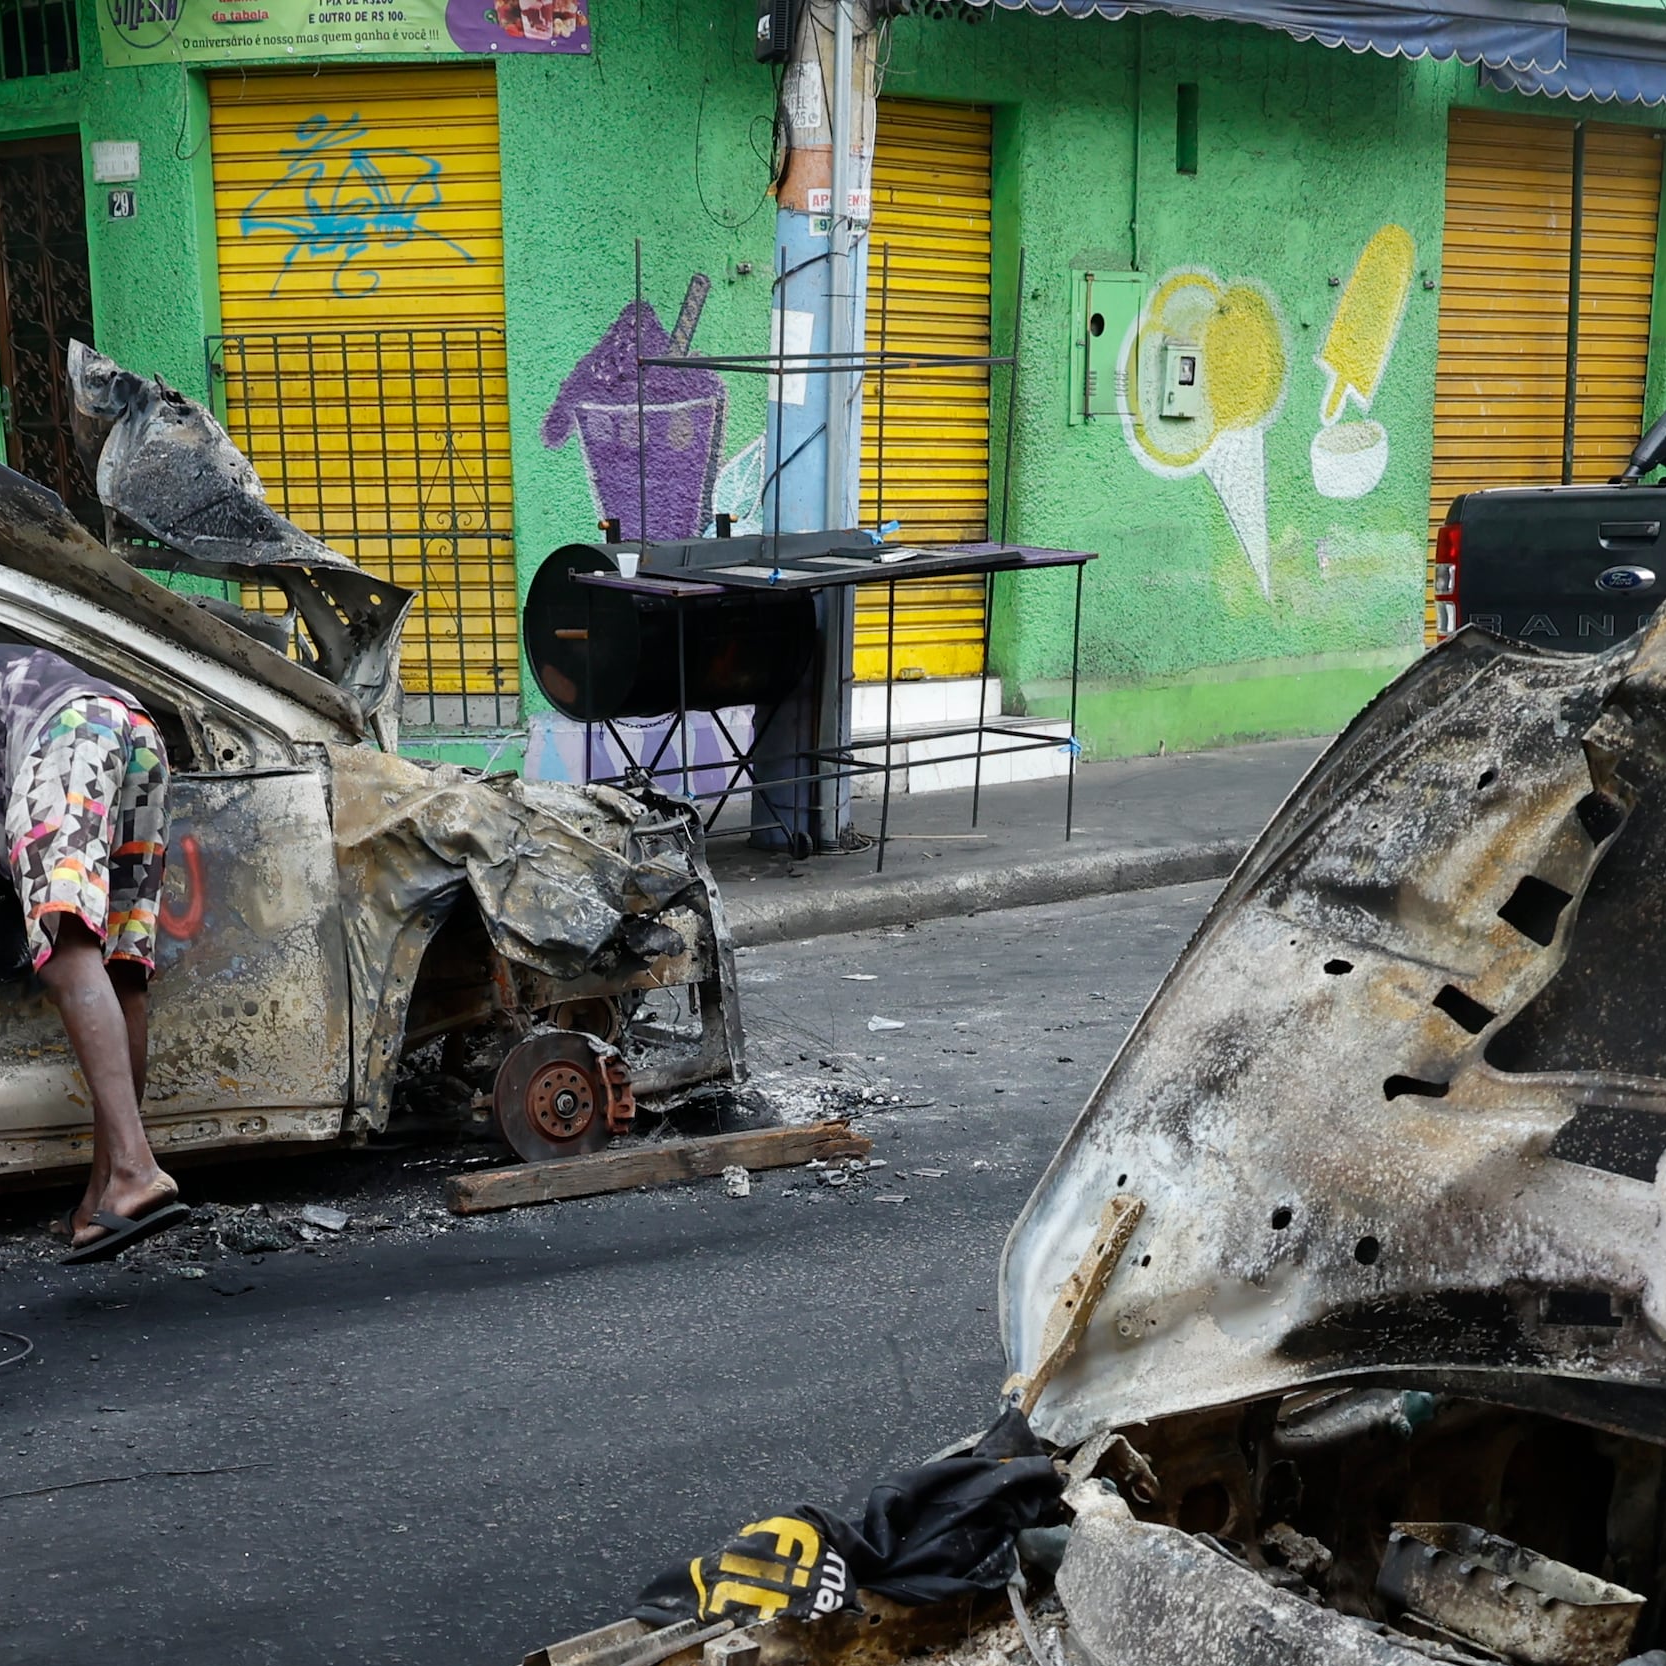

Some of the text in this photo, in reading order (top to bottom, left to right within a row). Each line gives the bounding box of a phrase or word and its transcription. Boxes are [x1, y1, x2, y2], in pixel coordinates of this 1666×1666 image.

[212, 9, 270, 22] da tabela
[308, 10, 407, 24] E OUTRO DE R$ 100.
[182, 38, 190, 49] O
[192, 34, 253, 49] aniversário
[255, 34, 261, 46] é
[263, 35, 294, 46] nosso
[296, 33, 319, 44] mas
[321, 31, 352, 45] quem
[354, 28, 390, 44] ganha
[392, 28, 399, 41] é
[401, 28, 427, 41] você
[113, 191, 130, 217] 29
[1610, 572, 1634, 586] Ford
